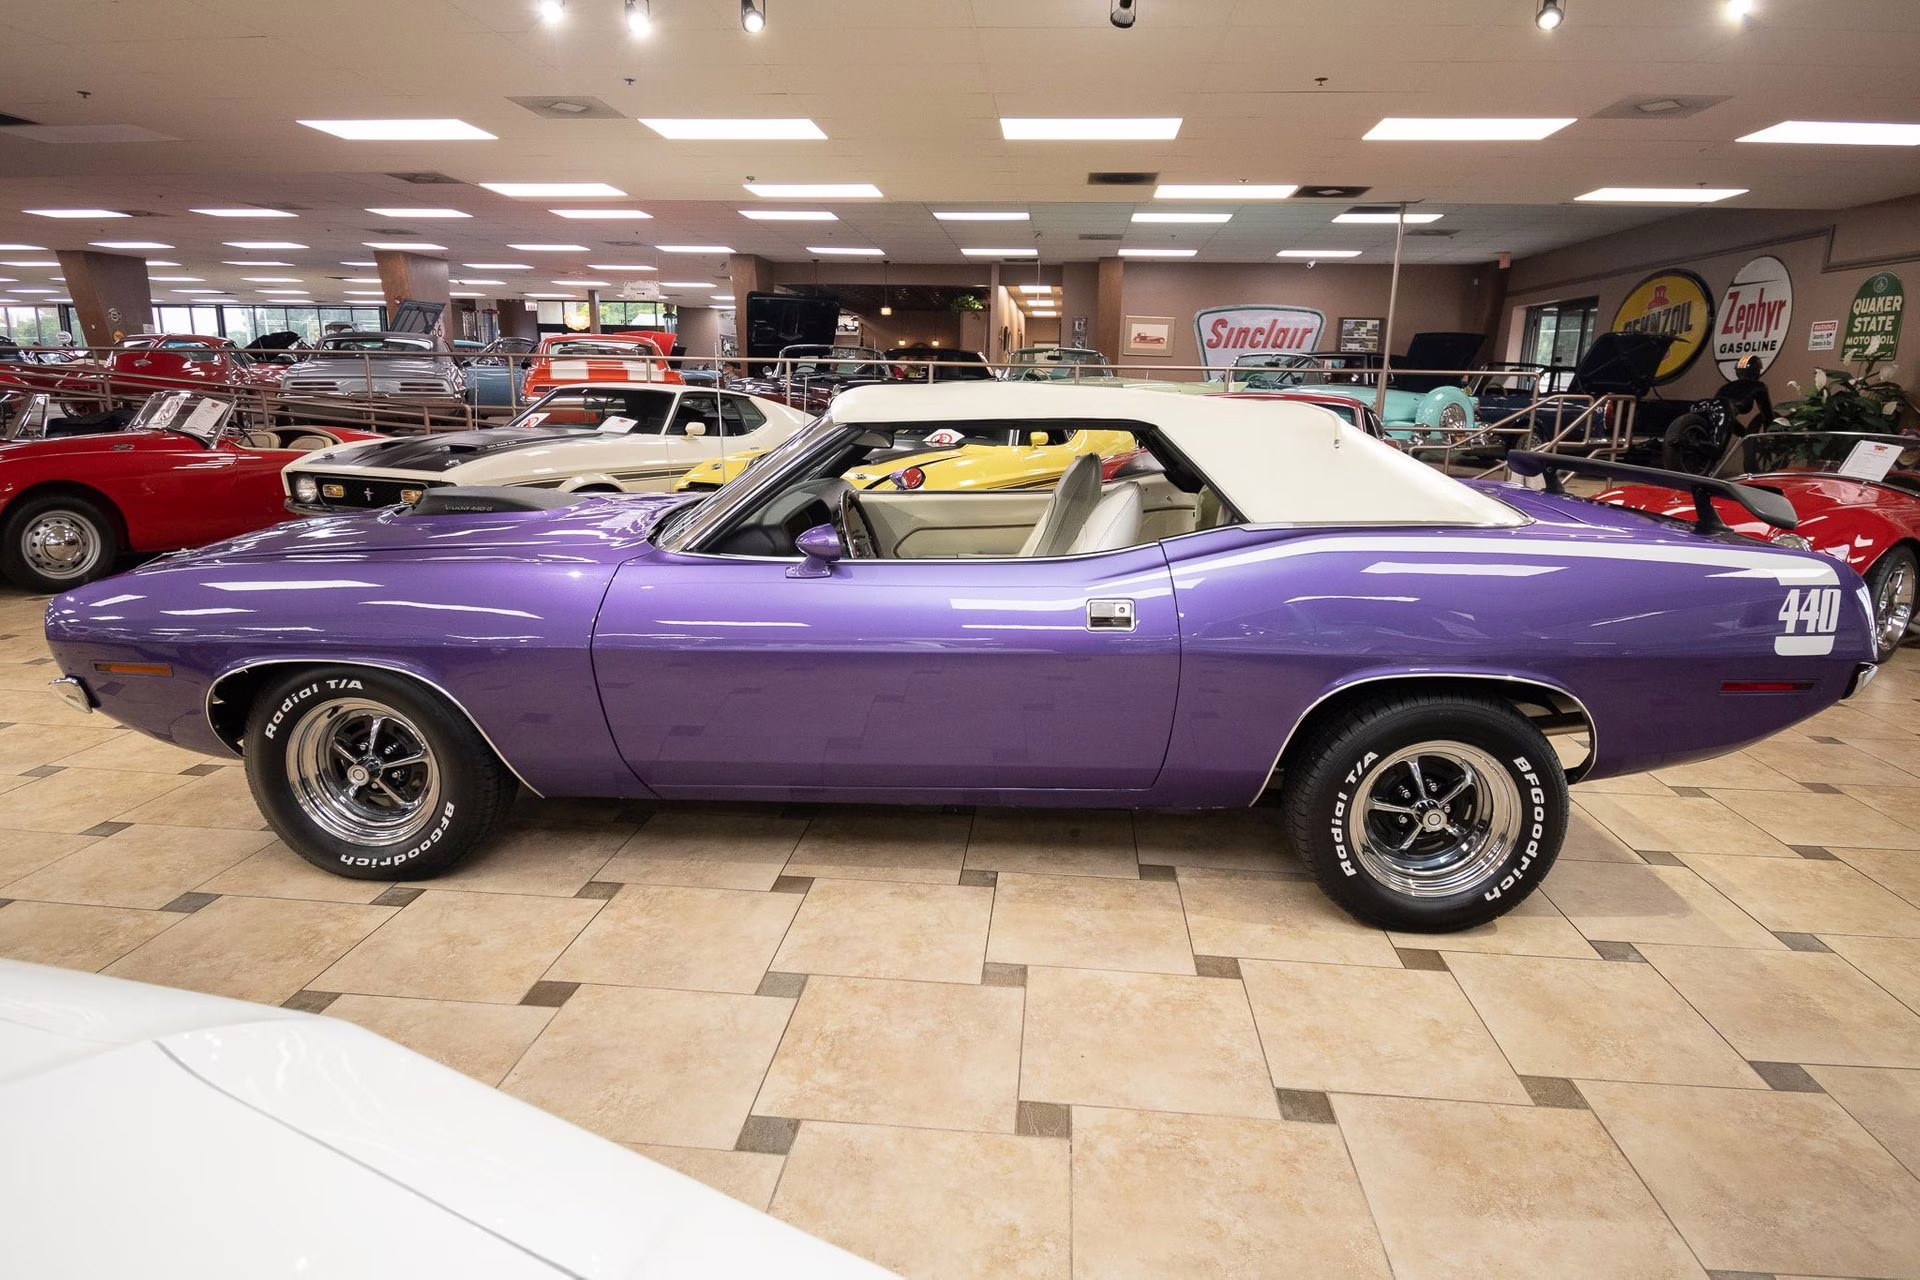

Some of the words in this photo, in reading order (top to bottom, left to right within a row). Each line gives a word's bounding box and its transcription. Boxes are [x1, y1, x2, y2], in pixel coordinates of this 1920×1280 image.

[1721, 287, 1787, 340] Zephyr
[1853, 295, 1903, 315] QUAKER
[1853, 316, 1895, 332] STATE
[1206, 318, 1315, 349] Sinclair
[1719, 340, 1778, 354] GASOLINE
[1880, 335, 1895, 344] OIL
[1778, 589, 1841, 633] 440
[264, 683, 319, 739] Radial
[326, 679, 363, 690] T/A
[340, 801, 455, 868] BFGoodrich
[1331, 792, 1357, 877] Radial
[1345, 751, 1379, 785] T/A
[1484, 756, 1545, 902] BFGoodrich
